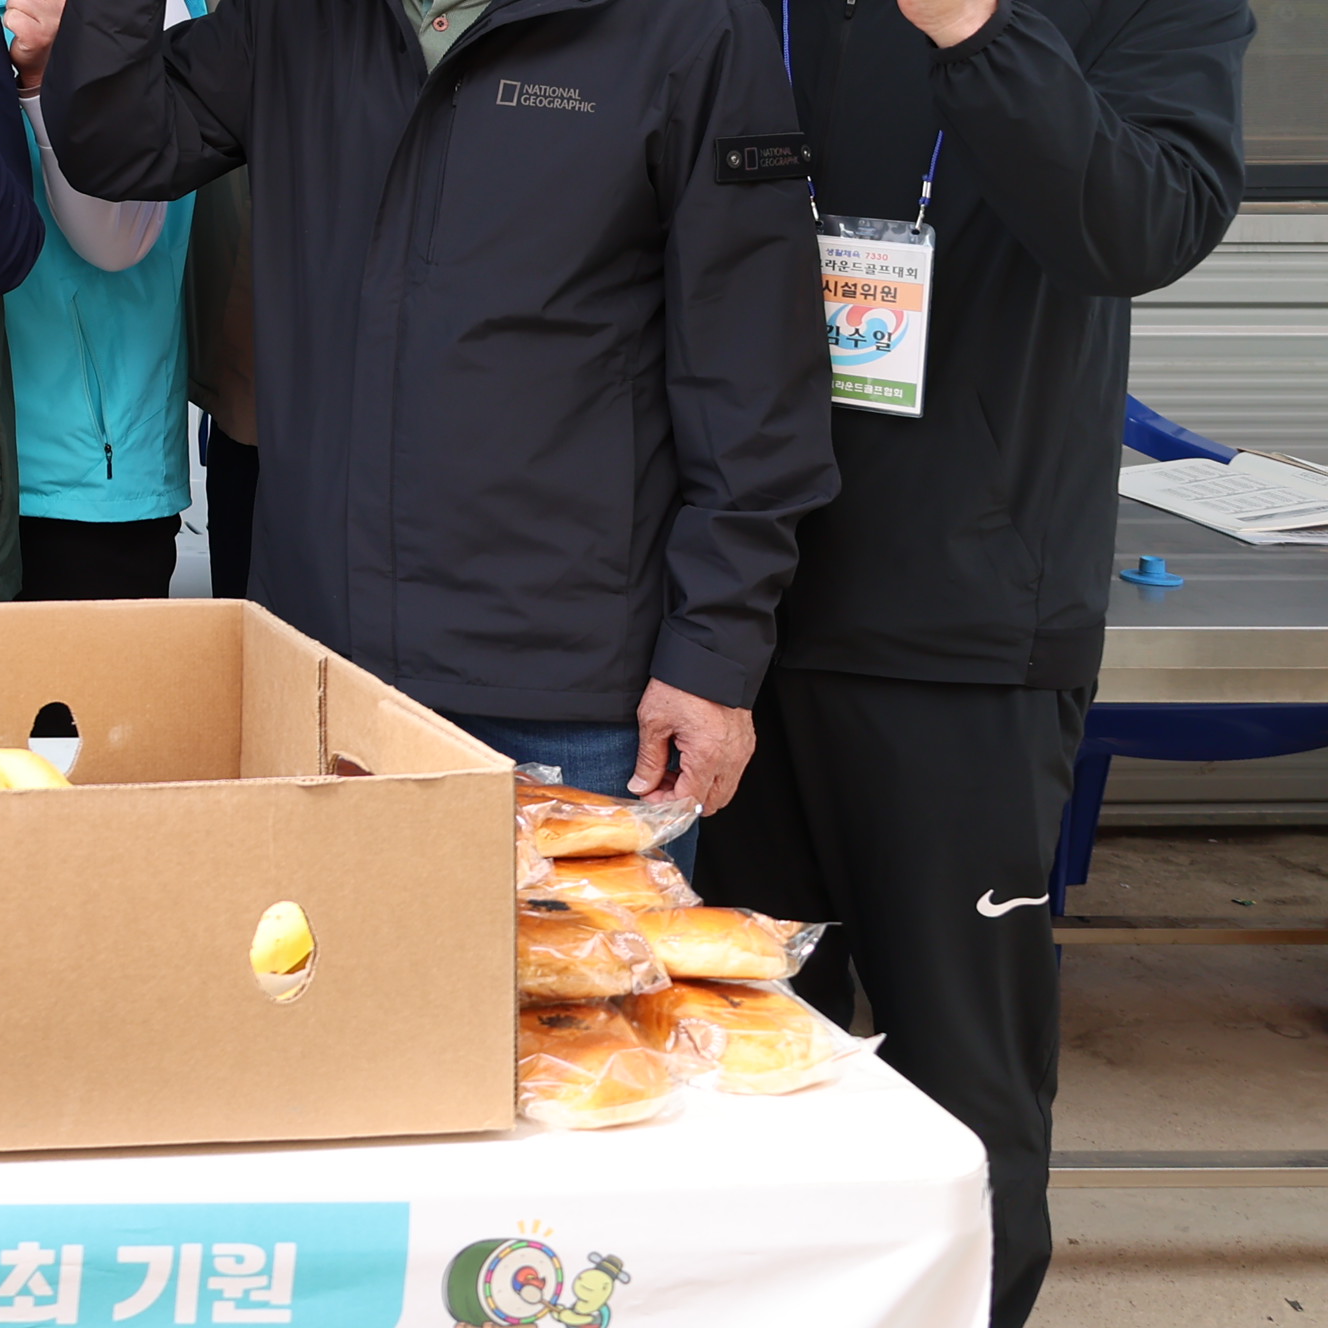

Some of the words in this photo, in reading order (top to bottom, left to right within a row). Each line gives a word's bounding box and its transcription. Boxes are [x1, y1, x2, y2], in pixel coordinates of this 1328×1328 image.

[523, 84, 581, 100] NATIONAL
[521, 95, 596, 113] GEOGRAPHIC
[865, 252, 889, 261] 7330
[820, 259, 918, 279] 라운드골프대회
[822, 280, 898, 303] 시설위원
[832, 380, 903, 398] 라운드골프협회
[113, 1241, 298, 1325] 기원
